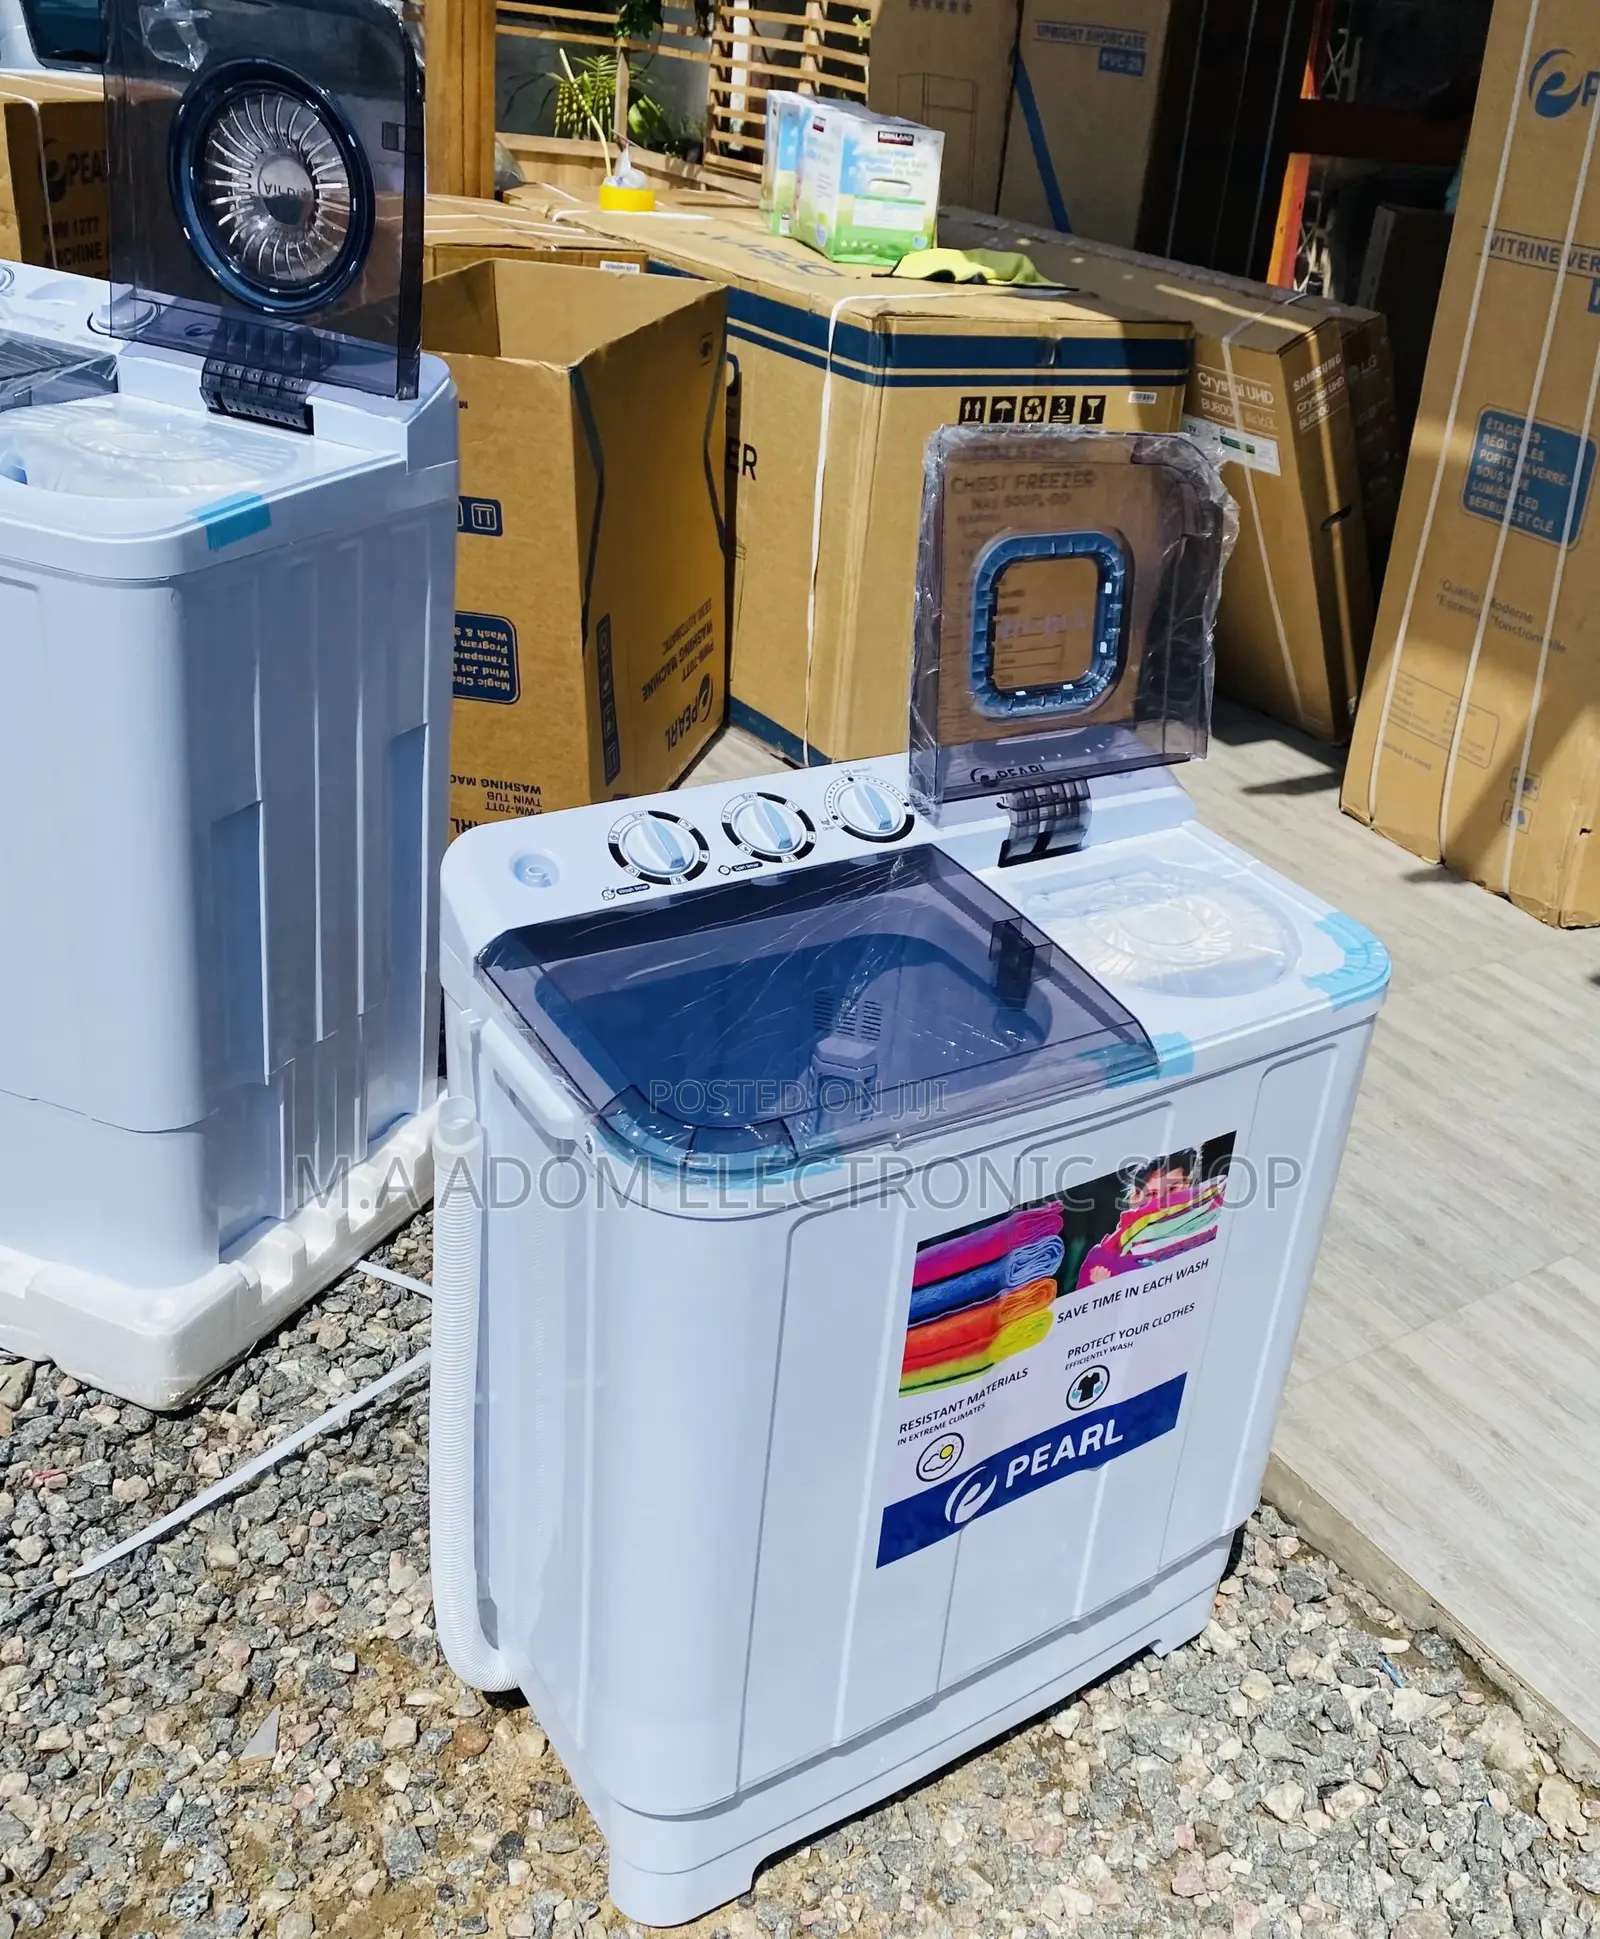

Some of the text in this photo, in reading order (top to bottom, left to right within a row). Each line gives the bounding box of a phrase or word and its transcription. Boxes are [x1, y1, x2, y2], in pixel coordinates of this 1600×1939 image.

[1490, 235, 1560, 264] VITRINE
[1246, 386, 1274, 405] UHD
[465, 628, 473, 637] &
[477, 629, 508, 642] Wash
[461, 640, 508, 654] Program
[461, 664, 479, 675] Jet
[482, 667, 510, 679] Wind
[477, 678, 510, 691] Magic
[665, 695, 700, 752] PEARL
[480, 778, 542, 795] WASHING
[487, 791, 542, 808] TWIN TUB
[1057, 1258, 1210, 1324] SAVE TIME IN EACH WASH
[1067, 1302, 1196, 1360] PROTECT YOUR CLOTHES
[1065, 1341, 1134, 1371] EFFICIENTLY WASH
[899, 1367, 1029, 1434] RESISTANT MATERIALS
[897, 1401, 986, 1446] IN EXTREME CLIMATES
[1004, 1418, 1124, 1489] PEARL
